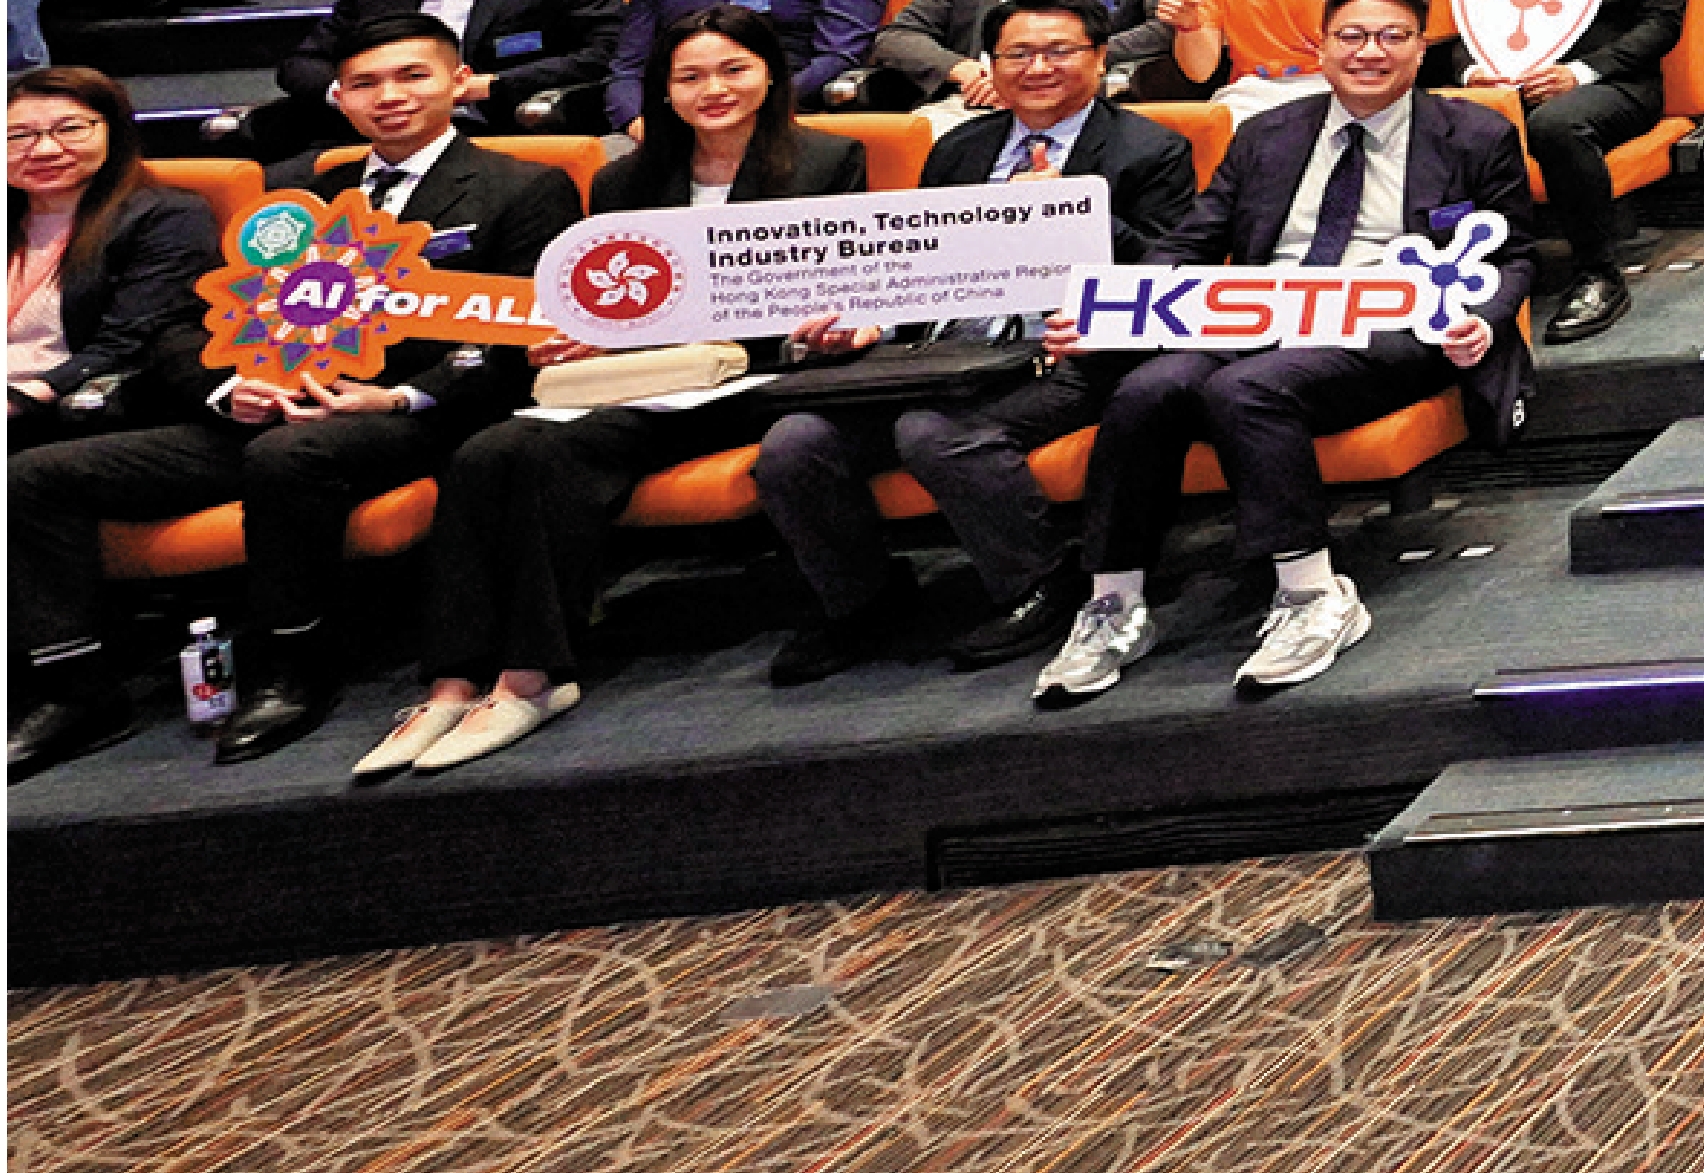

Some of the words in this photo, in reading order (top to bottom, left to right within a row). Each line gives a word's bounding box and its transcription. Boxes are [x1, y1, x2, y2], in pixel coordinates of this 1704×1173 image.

[707, 215, 867, 245] Innovation,
[874, 202, 1034, 231] Technology
[1041, 196, 1092, 217] and
[708, 244, 829, 268] Industry
[838, 235, 939, 258] Bureau
[710, 273, 743, 287] The
[746, 264, 858, 285] Government
[862, 261, 880, 274] of
[884, 259, 912, 272] the
[710, 290, 761, 307] Hong
[764, 284, 812, 302] Kong
[816, 277, 881, 298] Special
[886, 268, 1012, 292] Administrative
[284, 279, 347, 309] AI
[357, 285, 449, 318] for
[712, 308, 730, 323] of
[735, 305, 763, 320] the
[767, 298, 844, 319] People's
[849, 291, 928, 311] Republic
[932, 288, 950, 303] of
[953, 284, 1006, 301] China
[1076, 278, 1418, 337] HKSTP
